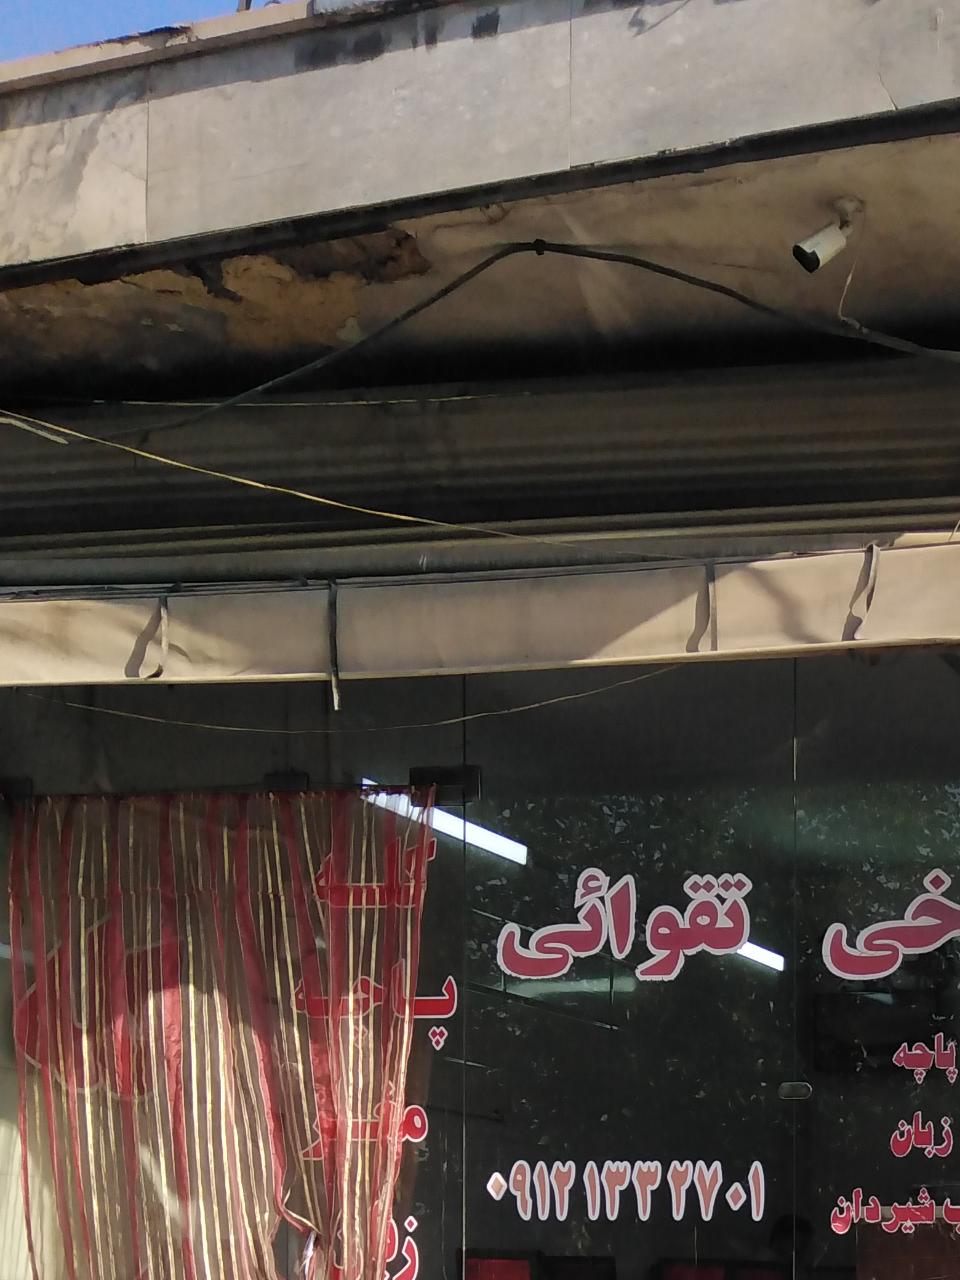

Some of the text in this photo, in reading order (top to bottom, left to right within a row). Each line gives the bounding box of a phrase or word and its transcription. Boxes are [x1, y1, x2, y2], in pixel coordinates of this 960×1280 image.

[495, 865, 753, 981] تقوائی
[891, 1031, 958, 1085] پاچه
[889, 1109, 955, 1159] زبان
[829, 1185, 937, 1236] شیردان
